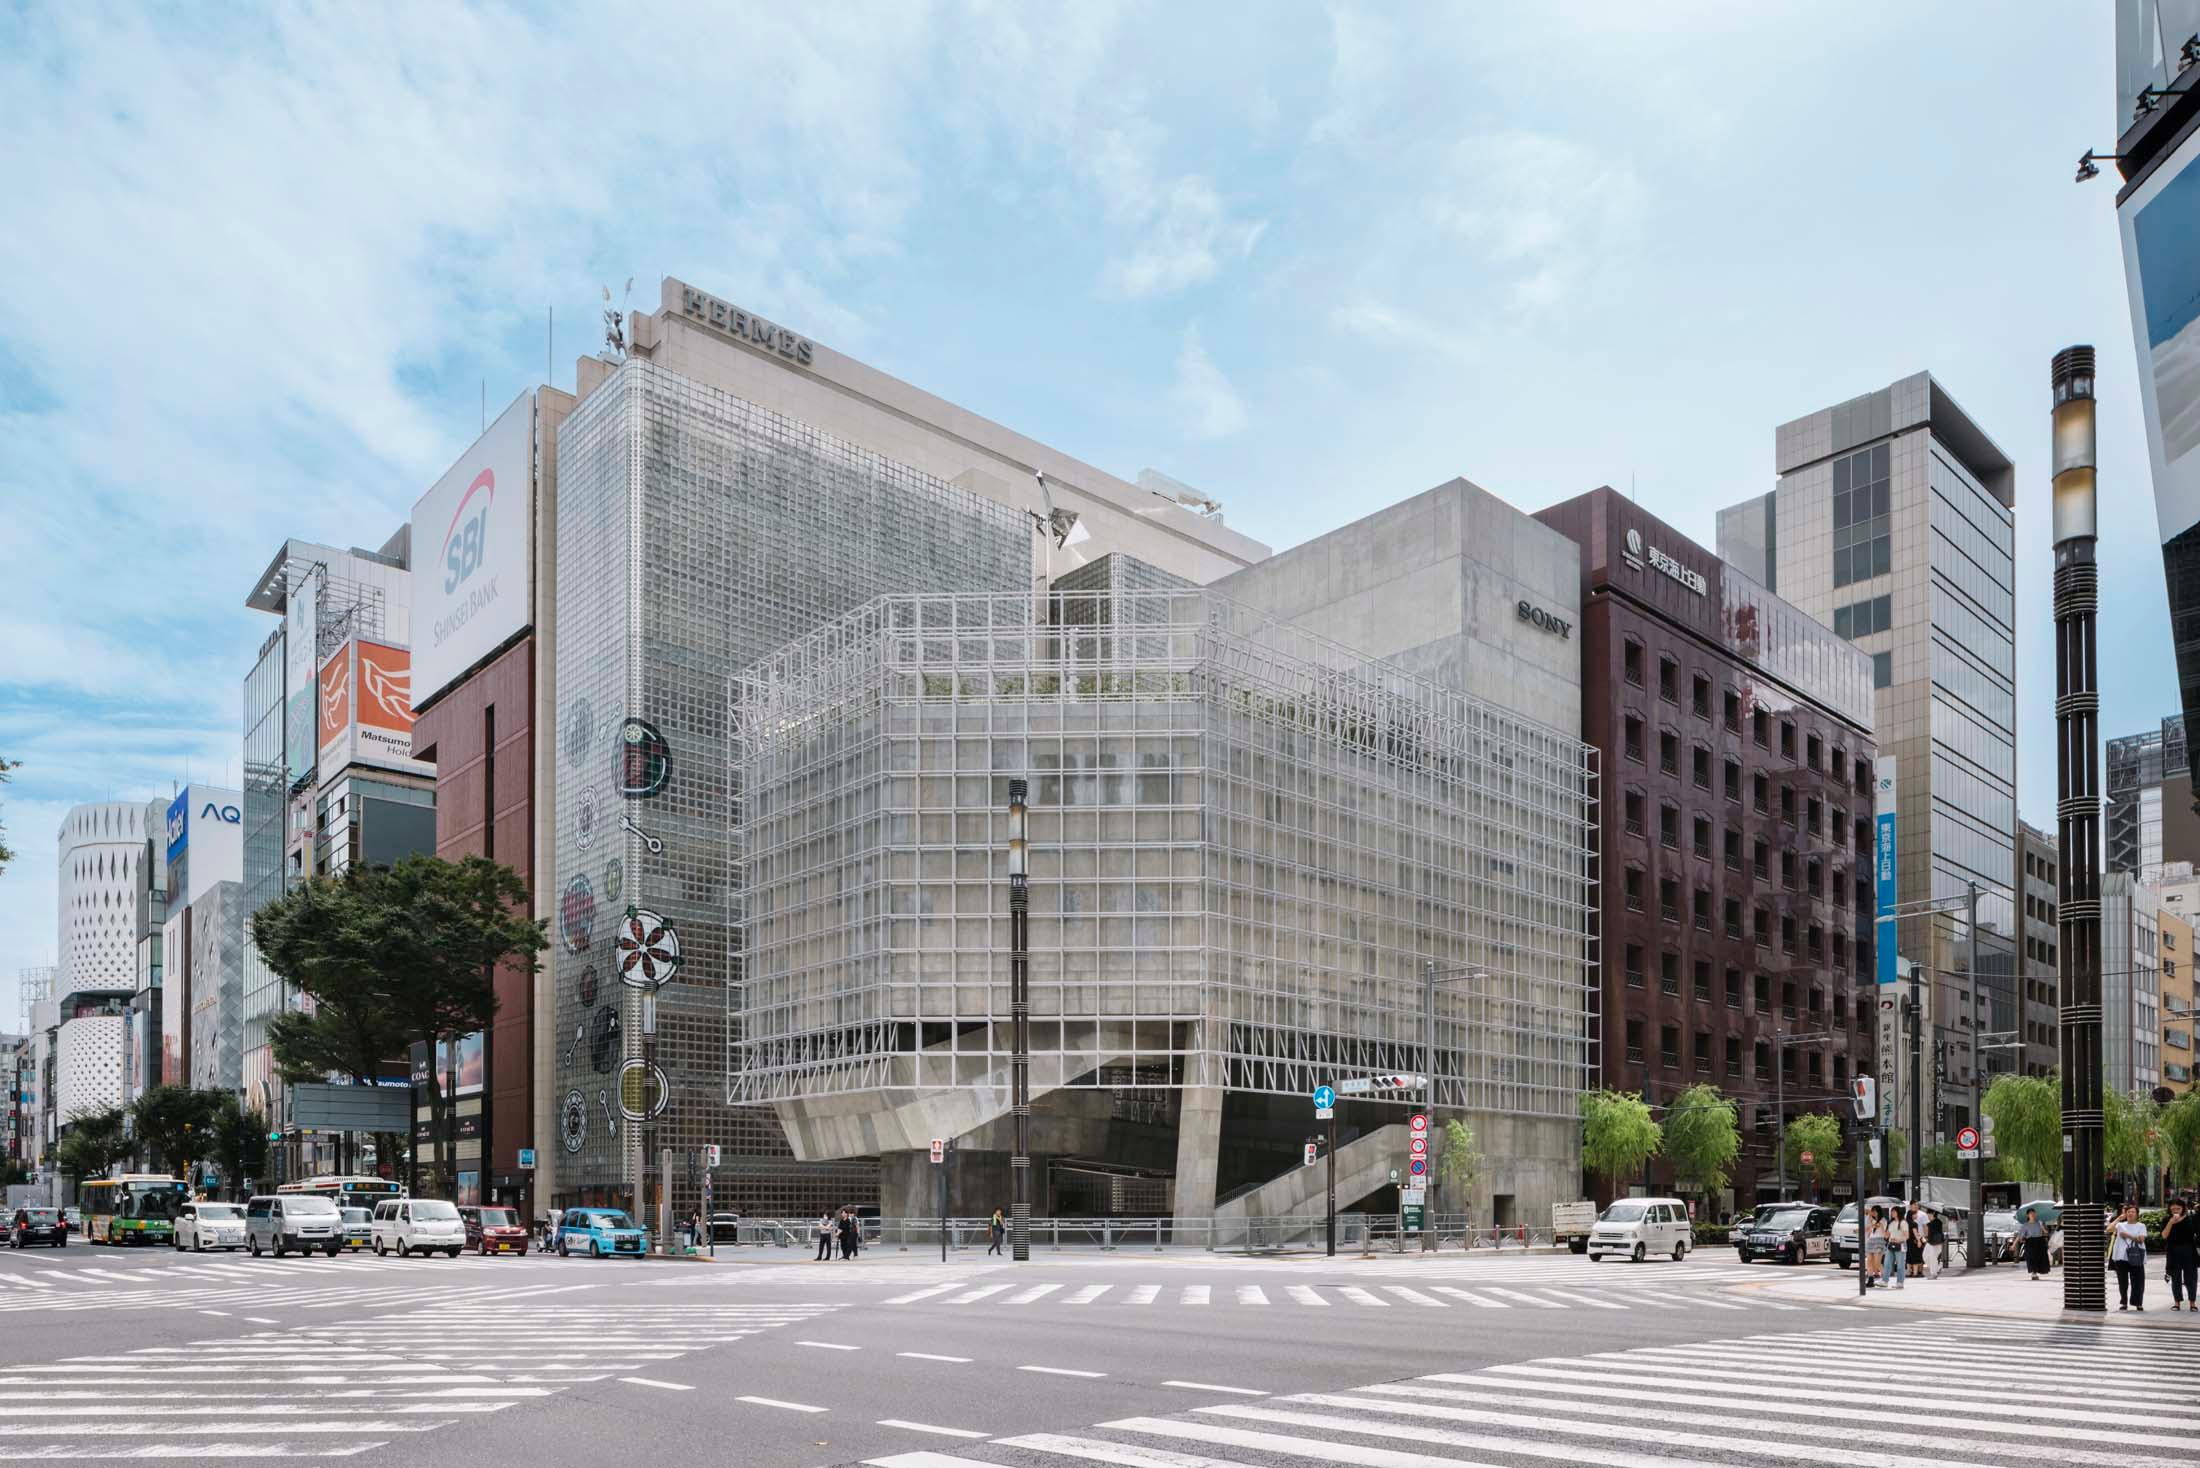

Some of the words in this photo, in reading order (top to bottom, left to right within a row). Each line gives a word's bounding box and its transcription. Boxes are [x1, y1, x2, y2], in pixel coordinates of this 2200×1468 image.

[444, 506, 488, 595] SBI
[1648, 545, 1707, 596] 東京海上日動
[433, 600, 469, 648] SHINSEI
[470, 576, 499, 617] BANK
[1518, 600, 1573, 640] SONY
[361, 730, 411, 748] Matsumo
[1881, 823, 1892, 881] 東京海上日動
[1937, 1039, 1945, 1122] VINTAGE
